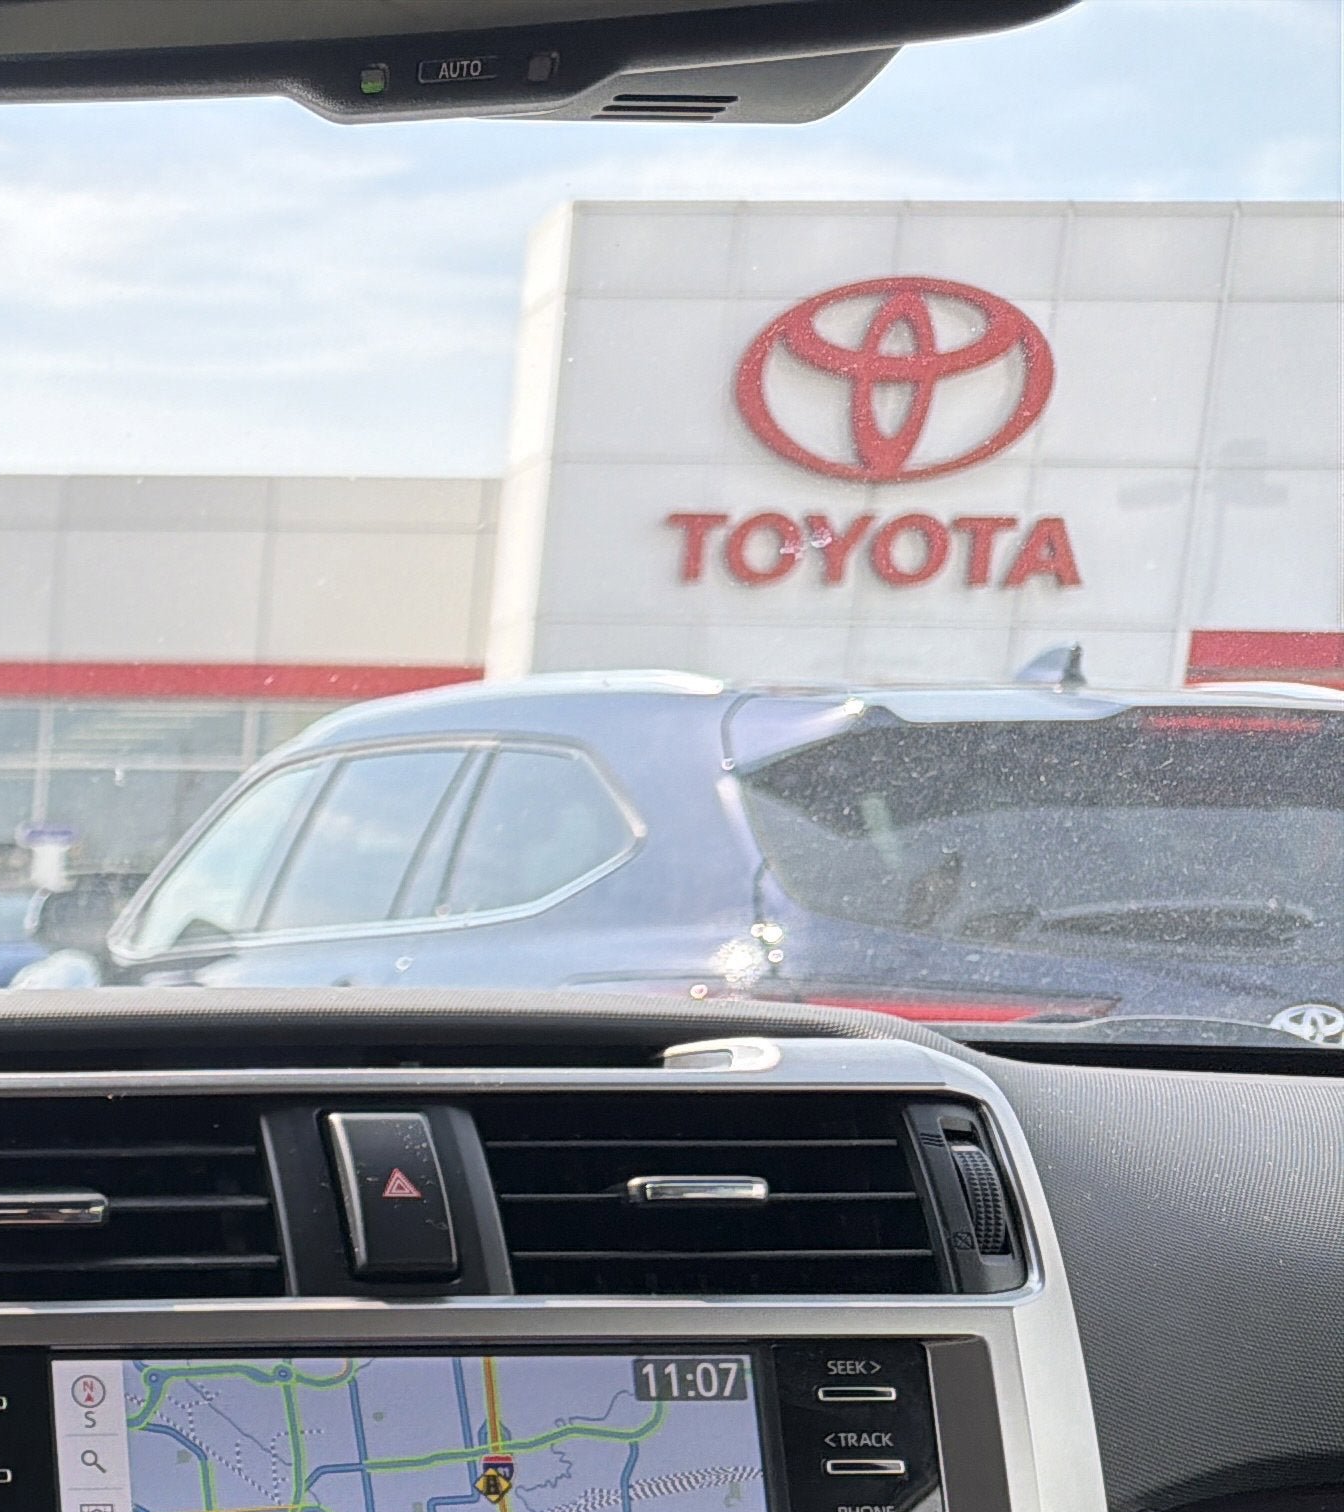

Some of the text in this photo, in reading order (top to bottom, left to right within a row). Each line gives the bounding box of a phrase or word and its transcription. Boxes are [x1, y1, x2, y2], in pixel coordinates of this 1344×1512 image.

[438, 60, 481, 78] AUTO
[665, 512, 1082, 591] TOYOTA
[641, 1362, 739, 1398] 11:07
